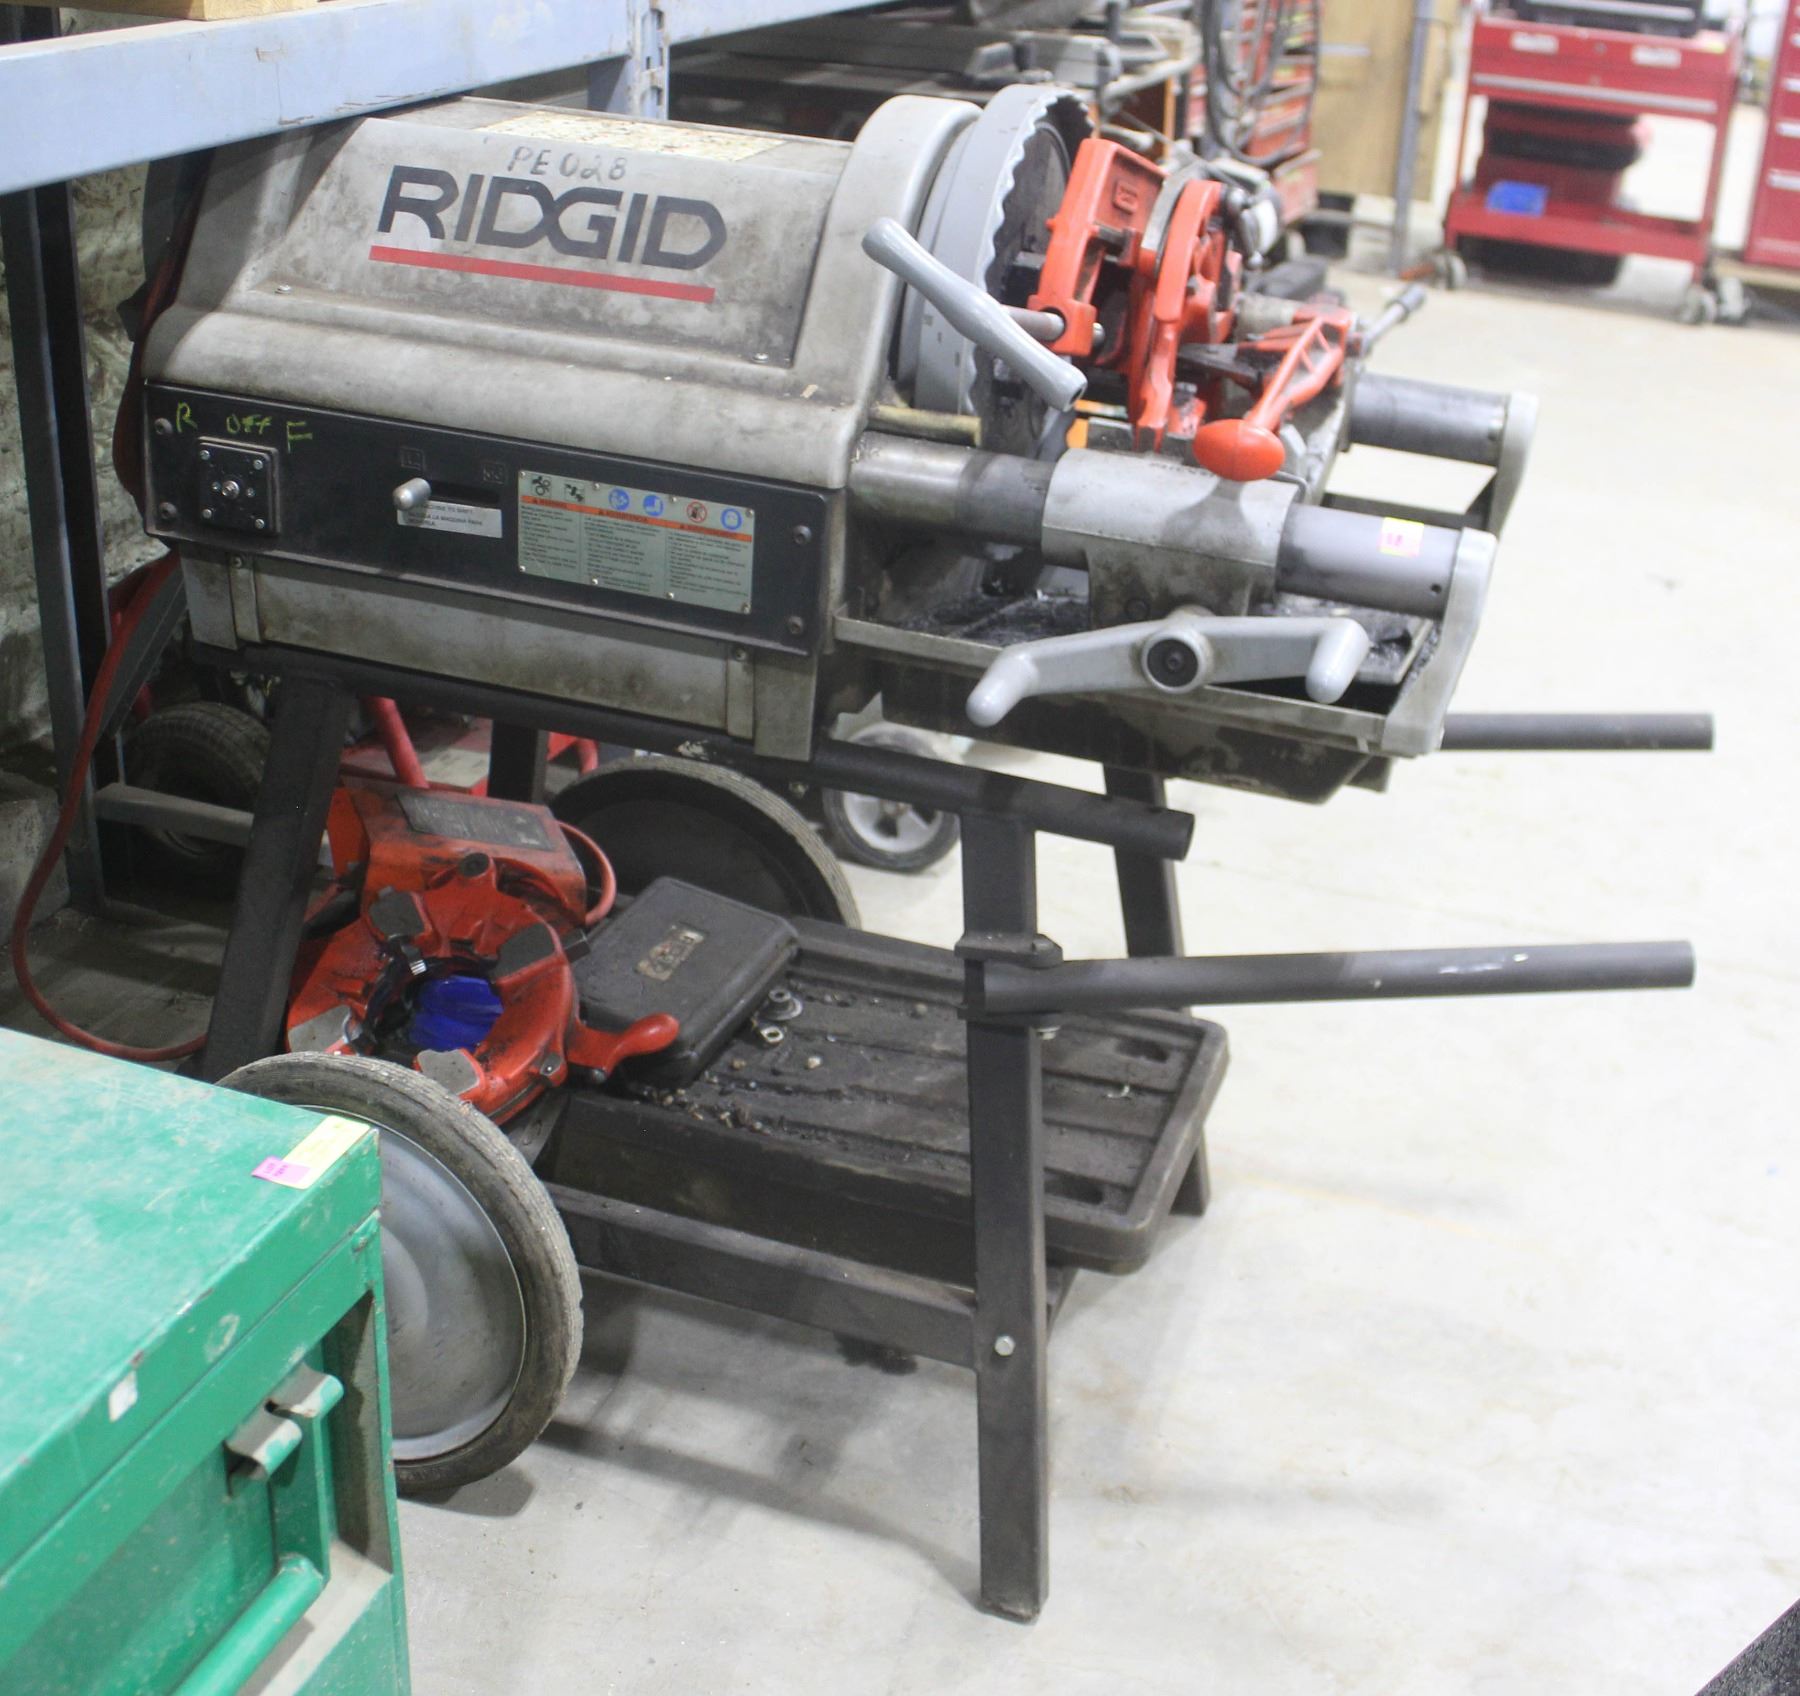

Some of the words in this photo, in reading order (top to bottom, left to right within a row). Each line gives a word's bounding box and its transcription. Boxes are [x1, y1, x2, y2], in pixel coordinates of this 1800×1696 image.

[377, 165, 727, 270] RIDGID
[176, 402, 198, 433] R
[286, 421, 313, 453] F
